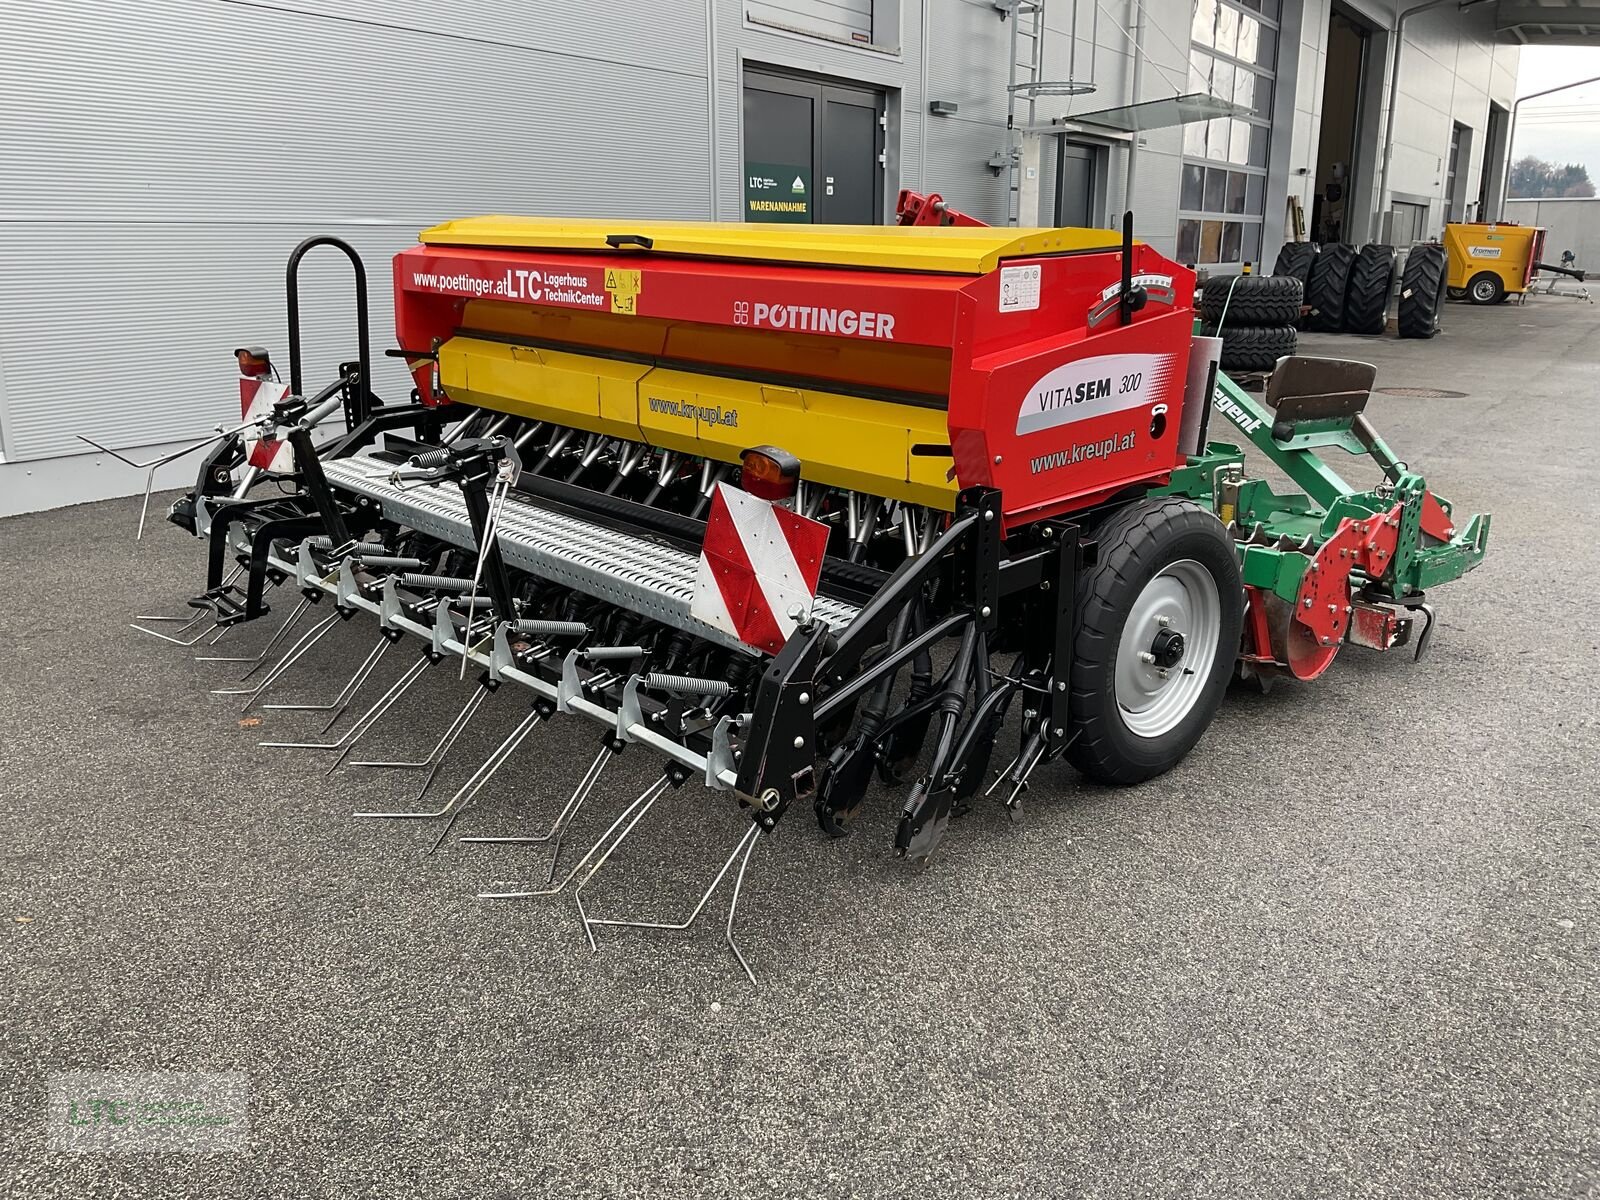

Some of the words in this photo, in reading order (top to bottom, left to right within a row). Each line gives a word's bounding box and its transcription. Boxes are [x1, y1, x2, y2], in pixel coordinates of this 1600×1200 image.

[749, 176, 763, 188] LTC
[749, 200, 807, 213] WARENANNAHME
[413, 271, 508, 297] www.poettinger.at
[507, 269, 541, 300] LTC
[544, 271, 588, 288] Lagerhaus
[544, 288, 604, 306] TechnikCenter
[753, 303, 895, 339] PÖTTINGER
[1039, 378, 1111, 411] VITASEM
[1119, 372, 1142, 394] 300
[648, 397, 738, 427] www.kreupl.at
[1213, 381, 1262, 434] egent
[1031, 430, 1136, 474] www.kreupl.at
